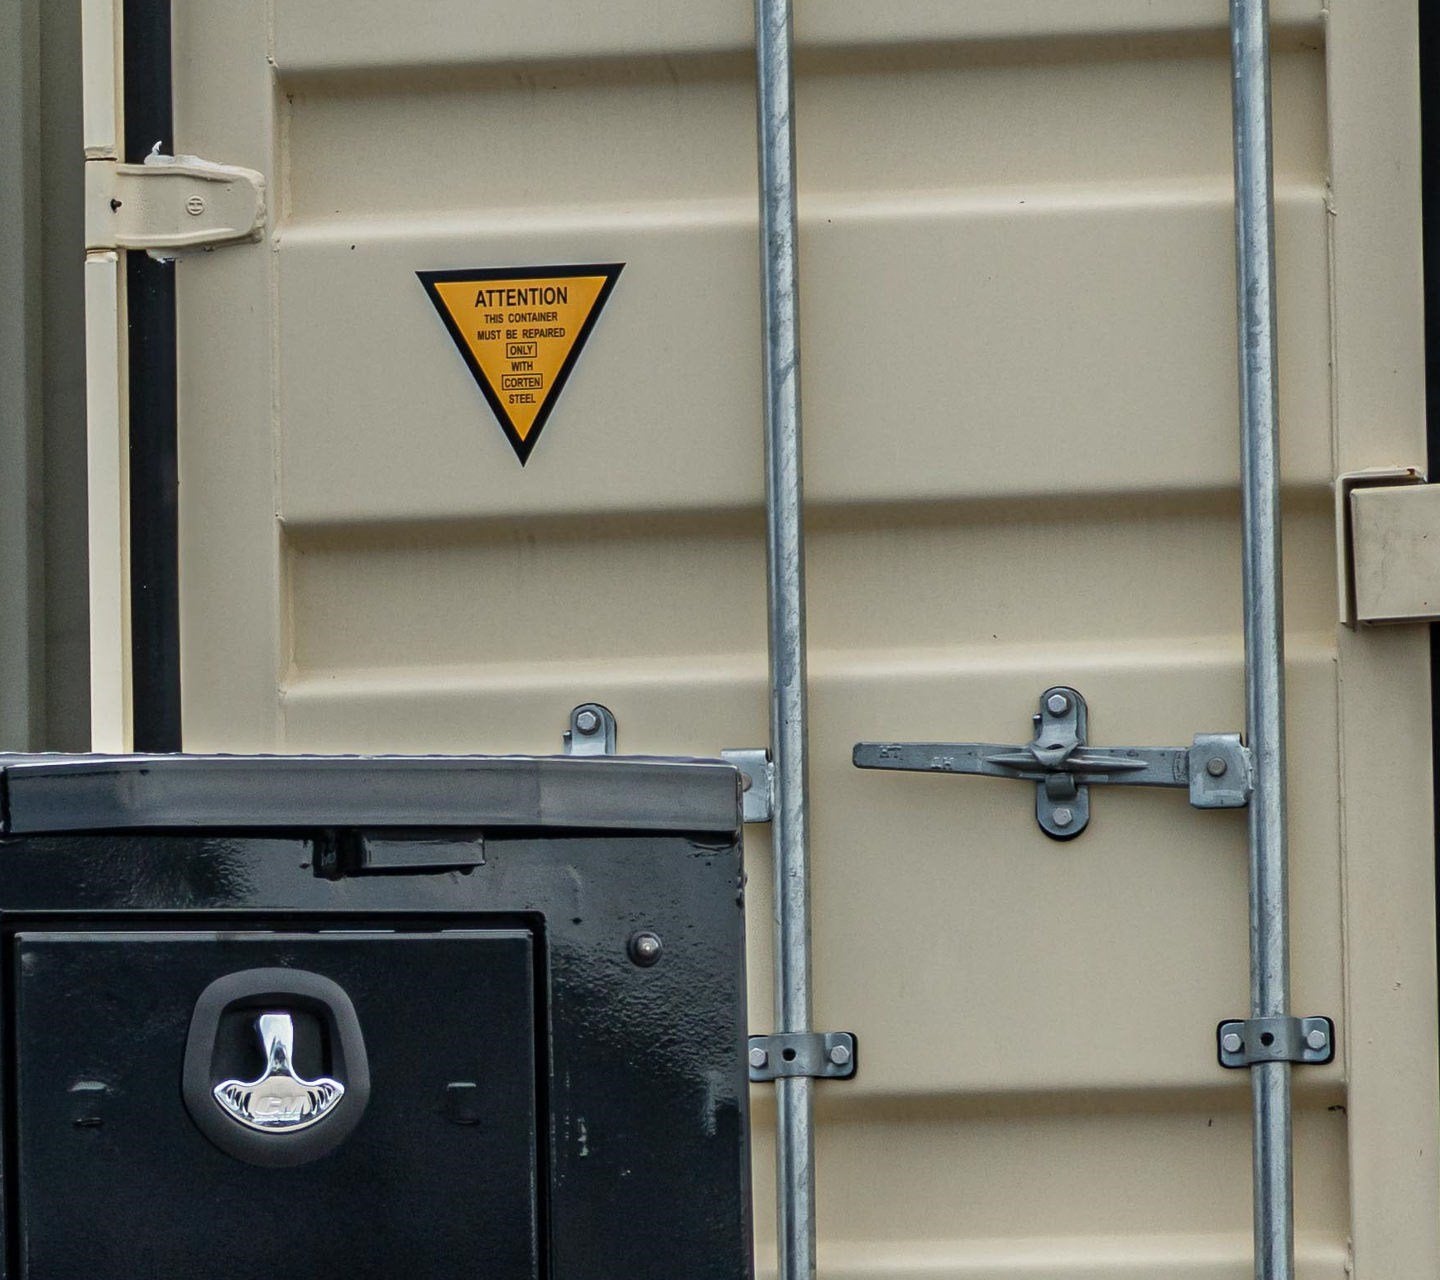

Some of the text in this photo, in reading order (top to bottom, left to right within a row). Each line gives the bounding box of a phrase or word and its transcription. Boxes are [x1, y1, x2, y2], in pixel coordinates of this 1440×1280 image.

[475, 286, 568, 308] ATTENTION
[484, 311, 558, 324] THIS CONTAINER
[477, 327, 565, 341] MUST BE REPAIRED
[510, 345, 533, 356] ONLY
[511, 361, 533, 372] WITH
[504, 376, 541, 388] CORTEN
[509, 394, 536, 405] STEEL
